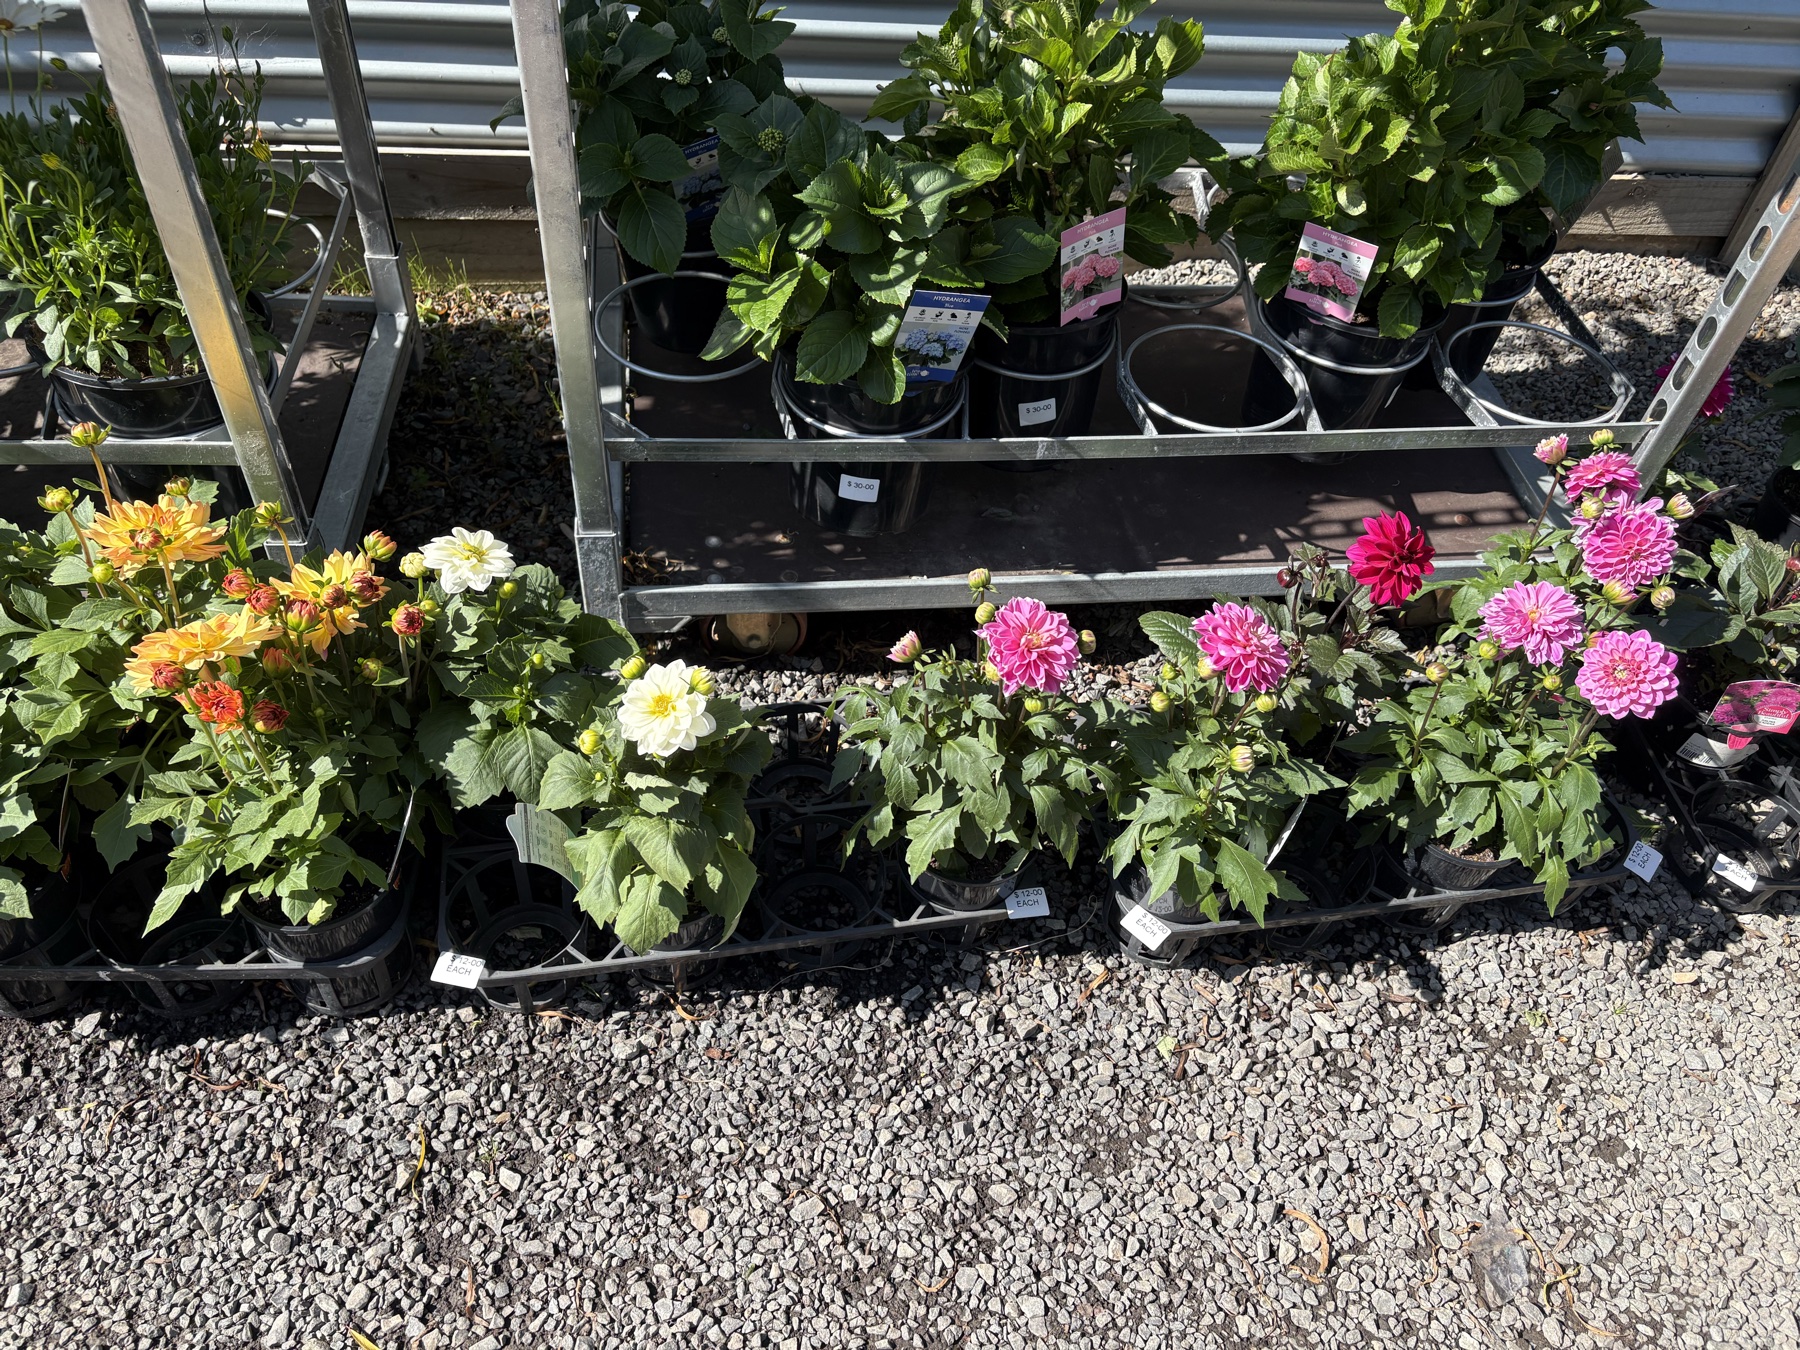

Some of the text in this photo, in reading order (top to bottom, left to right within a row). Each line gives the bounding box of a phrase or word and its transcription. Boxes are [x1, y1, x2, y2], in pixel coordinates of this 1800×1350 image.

[684, 139, 718, 155] HYDRANGEA
[1076, 217, 1109, 234] HYDRANGEA
[1322, 231, 1358, 247] HYDRANGEA
[933, 295, 971, 304] HYDRANGEA
[1631, 843, 1644, 858] 12-00
[1637, 851, 1652, 869] EACH
[1725, 865, 1747, 880] EACH
[1021, 888, 1043, 898] 12-00
[1016, 899, 1040, 908] EACH
[1135, 918, 1158, 938] EACH
[1148, 917, 1169, 935] 12-00
[450, 954, 482, 968] $ 12-00
[446, 964, 472, 975] EACH
